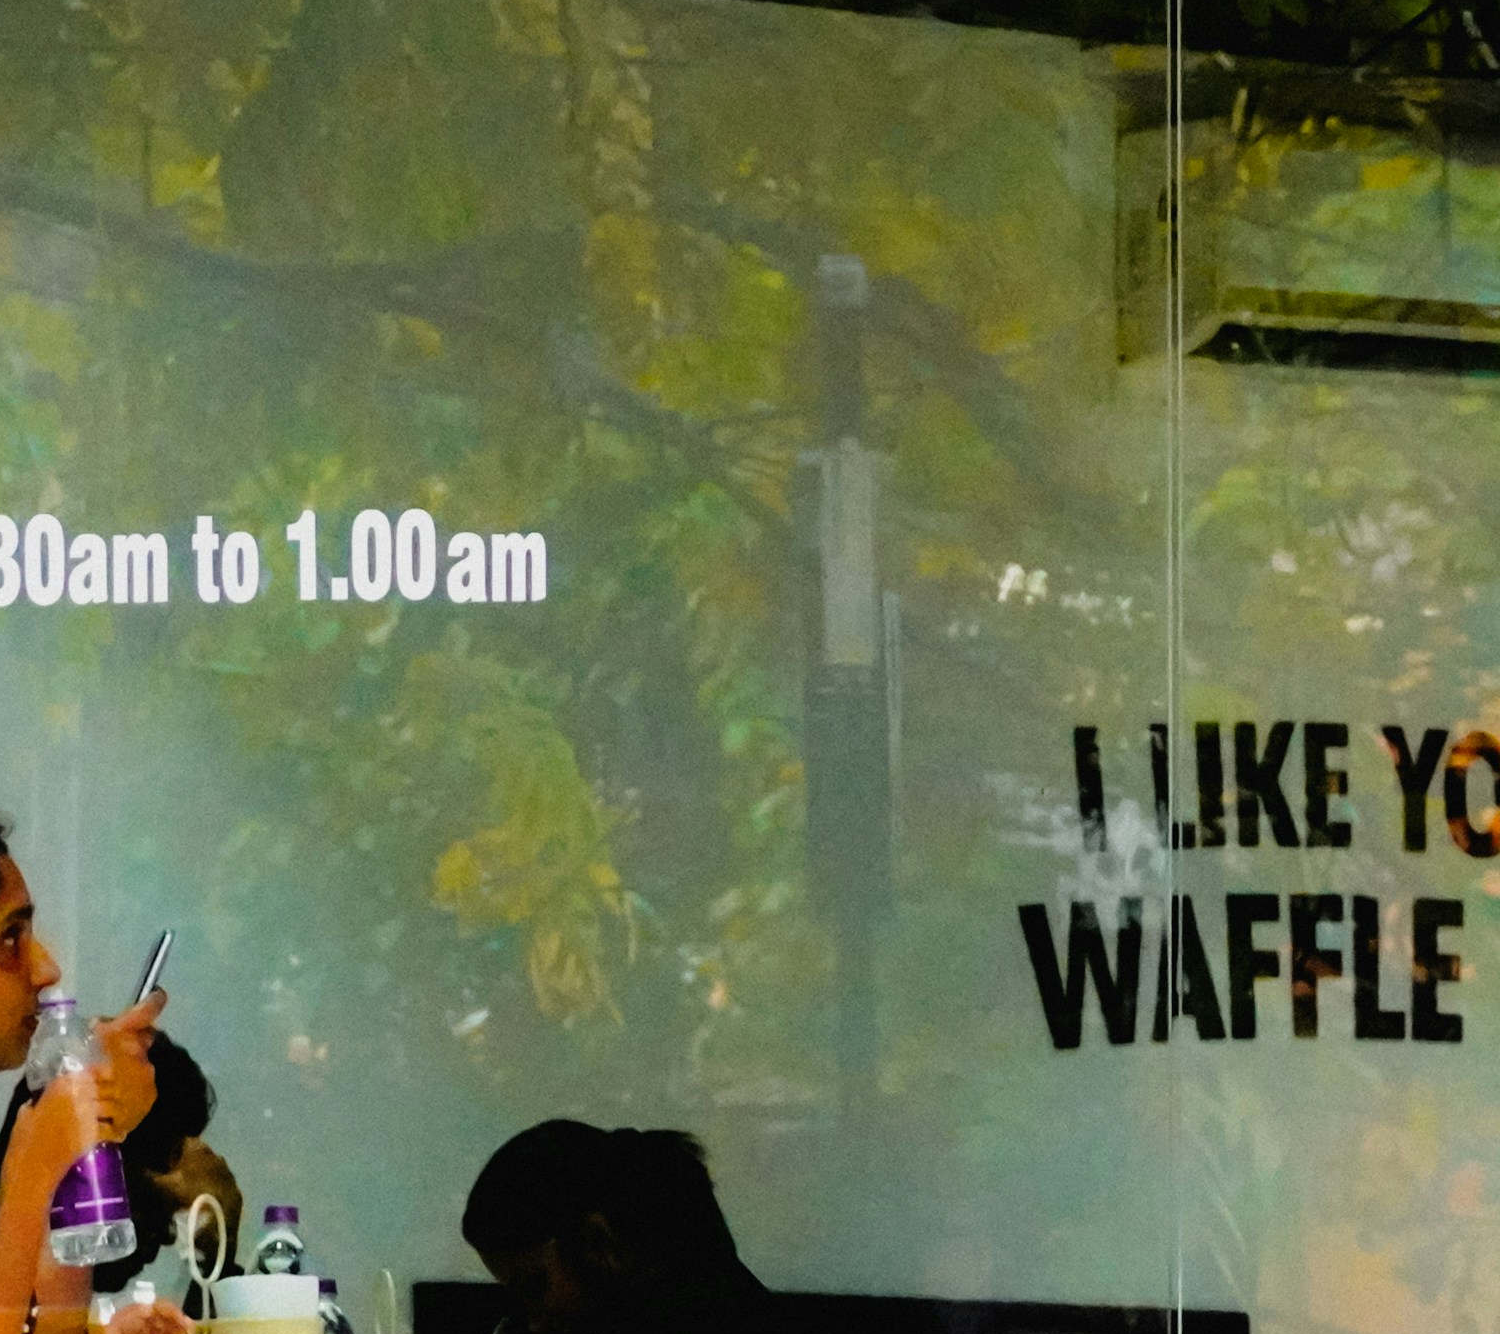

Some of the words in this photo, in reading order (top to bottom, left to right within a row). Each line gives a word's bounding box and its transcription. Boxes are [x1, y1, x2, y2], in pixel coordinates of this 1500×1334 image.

[192, 514, 260, 605] to
[1073, 725, 1107, 853] I
[1149, 721, 1352, 850] LIKE
[1017, 892, 1463, 1050] WAFFLE
